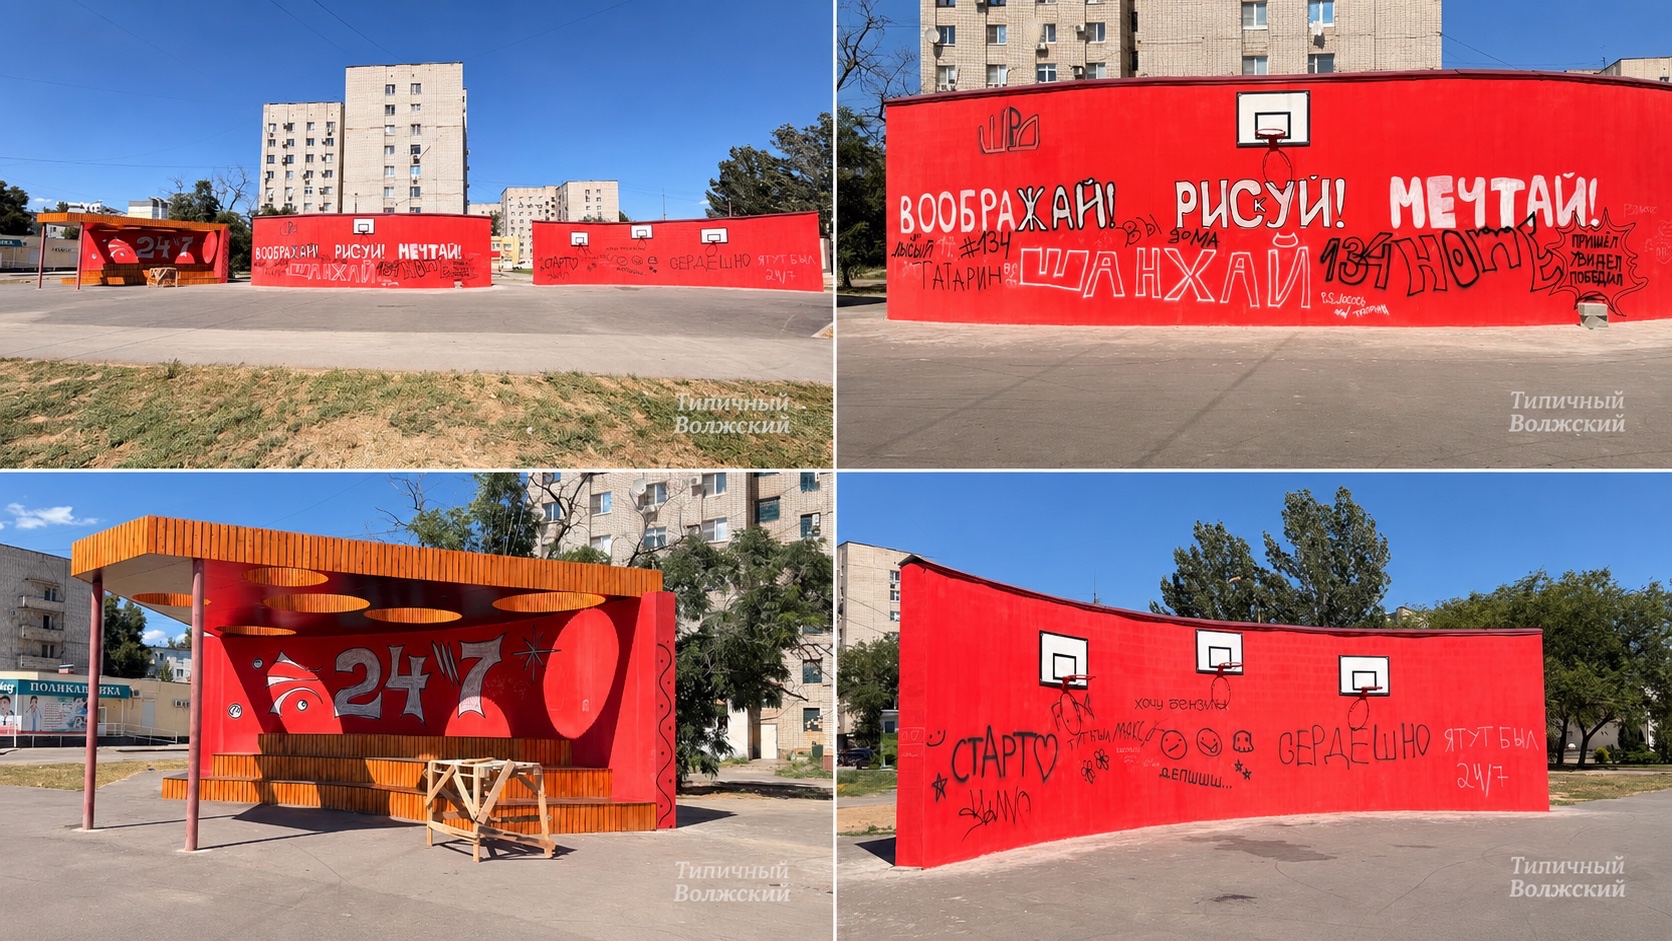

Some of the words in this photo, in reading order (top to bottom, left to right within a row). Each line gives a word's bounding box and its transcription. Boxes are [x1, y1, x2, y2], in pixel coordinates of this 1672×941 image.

[900, 178, 1116, 234] ВООБРАЖАЙ!
[1389, 171, 1600, 229] МЕЧТАЙ!
[398, 241, 462, 260] МЕЧТАЙ!
[959, 230, 1012, 260] #134
[289, 259, 376, 284] ШАНХАЙ
[1018, 231, 1311, 309] ШАНХАЙ
[1320, 231, 1394, 291] 134
[1569, 251, 1622, 272] УВИДЕЛ
[1569, 270, 1623, 288] ПОБЕДИЛ
[1499, 726, 1539, 751] БЫЛ
